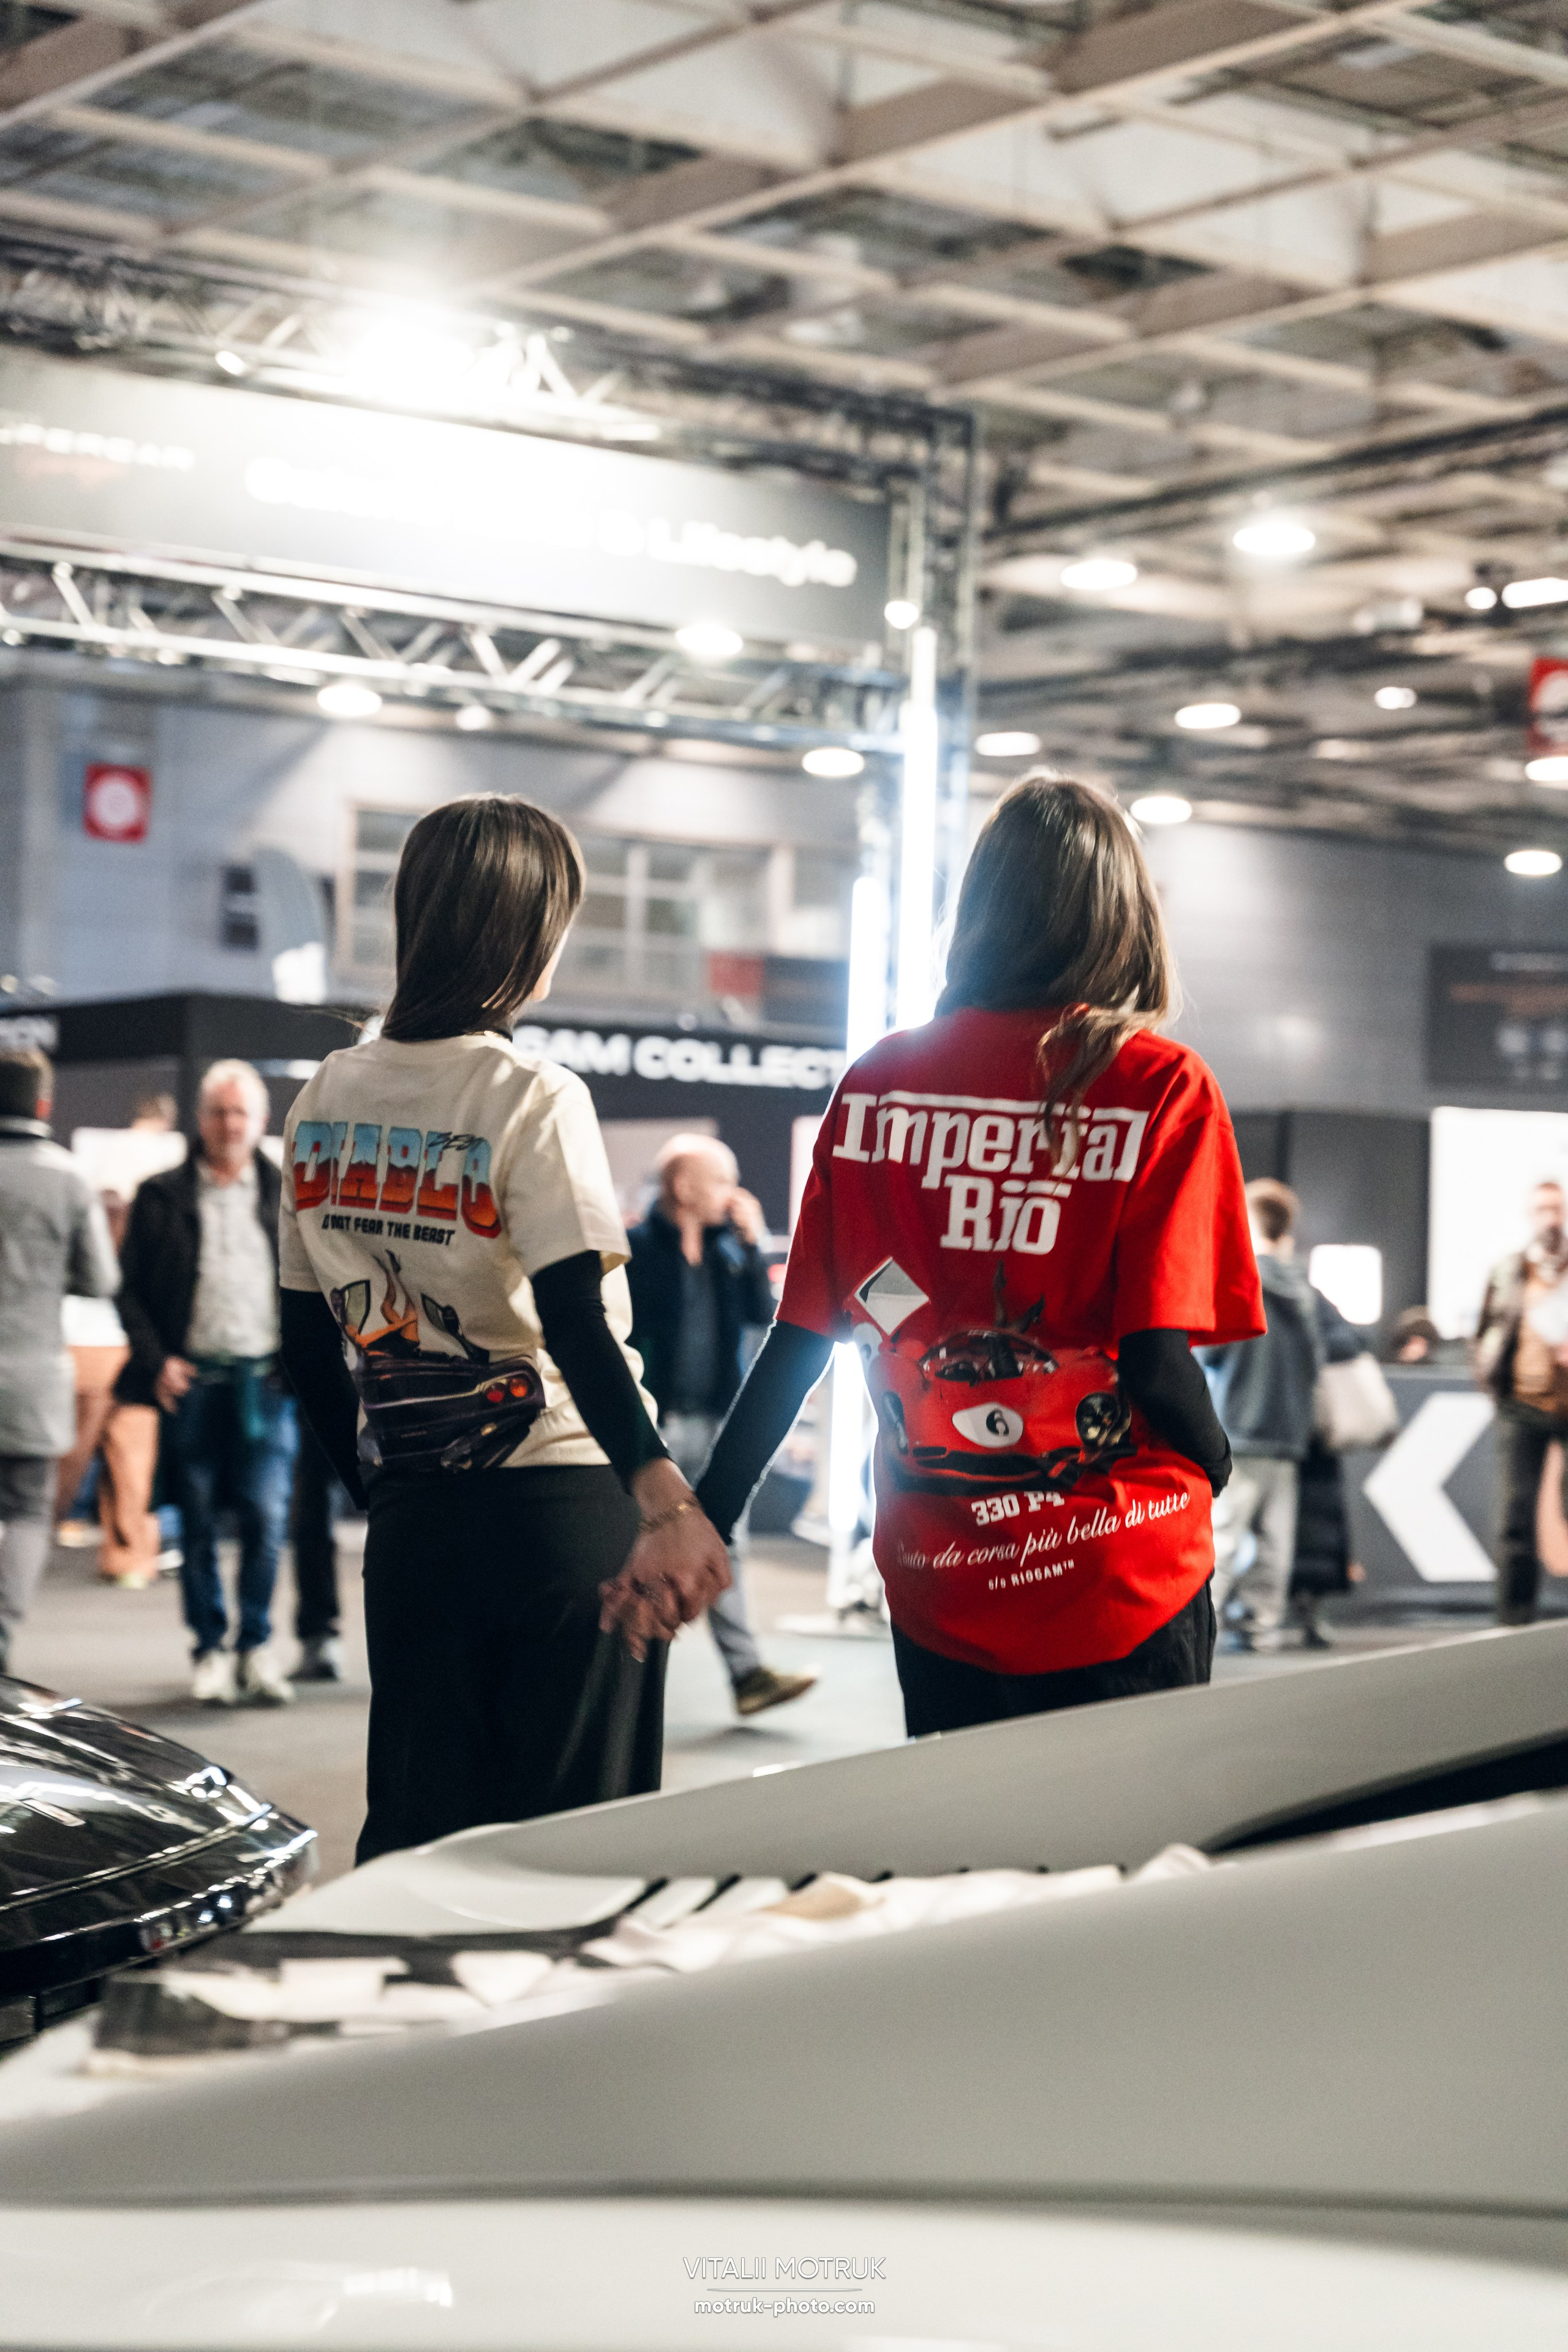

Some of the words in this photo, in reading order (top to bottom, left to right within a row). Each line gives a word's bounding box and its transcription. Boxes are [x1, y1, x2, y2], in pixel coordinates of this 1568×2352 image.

[832, 1090, 1150, 1189] Imperial
[292, 1120, 502, 1238] DIABLO
[353, 1216, 384, 1235] FEAR
[386, 1221, 411, 1240] THE
[413, 1224, 456, 1246] BEAST
[986, 1409, 1009, 1436] 6
[933, 1540, 965, 1569] da
[967, 1542, 1020, 1566] corsa
[1067, 1506, 1121, 1545] bella
[1125, 1498, 1145, 1528] di
[1148, 1492, 1190, 1520] tutte
[971, 1493, 1020, 1526] 330
